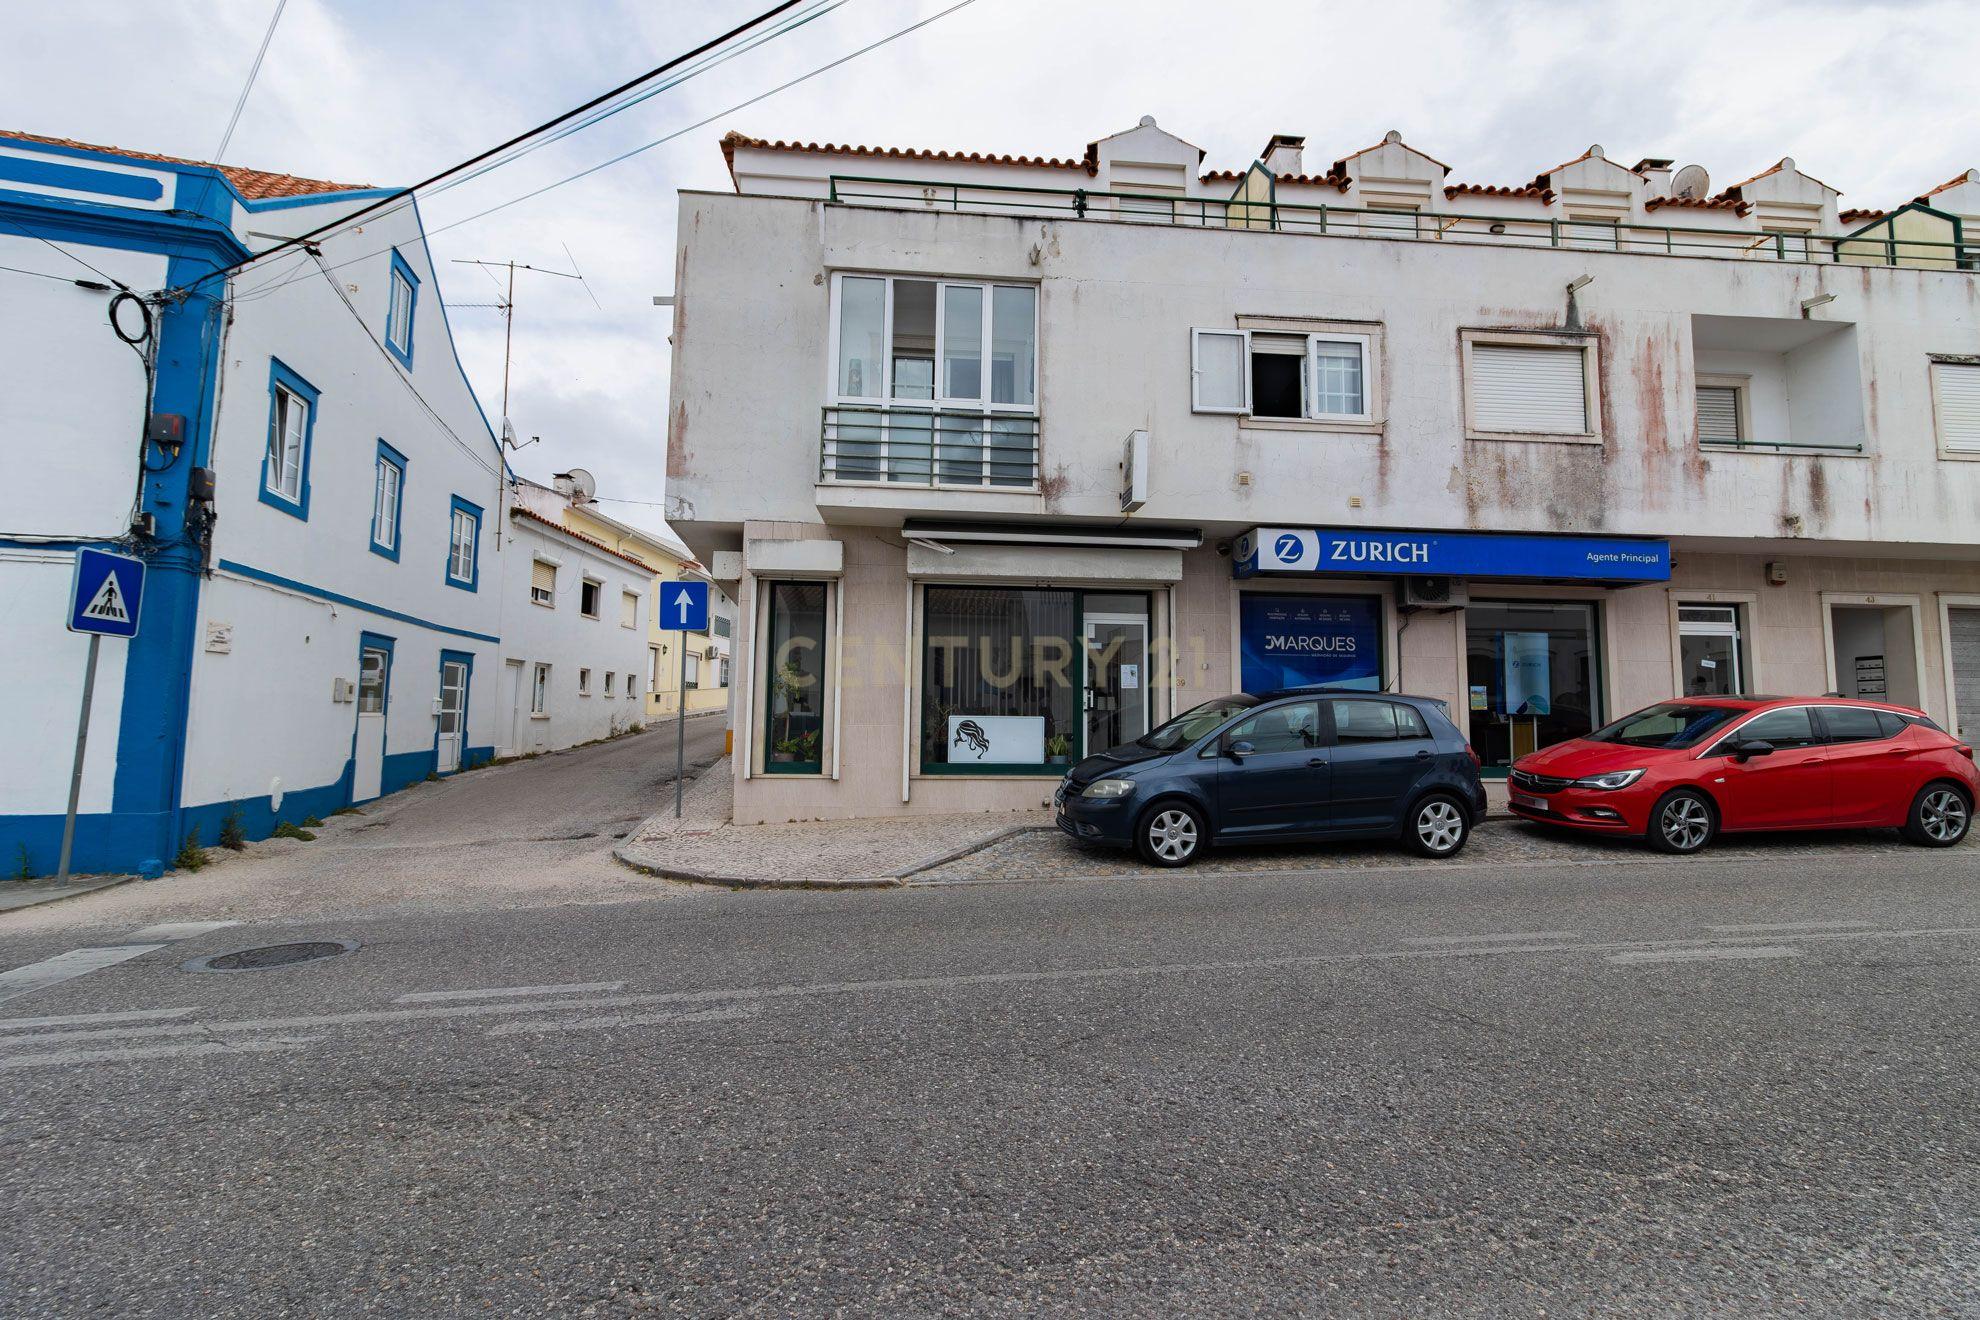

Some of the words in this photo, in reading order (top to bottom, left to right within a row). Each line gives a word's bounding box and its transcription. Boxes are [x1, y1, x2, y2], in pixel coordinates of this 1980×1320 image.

[1331, 540, 1429, 562] ZURICH
[1586, 552, 1619, 563] Agente
[1621, 553, 1659, 564] Principal
[1265, 635, 1356, 651] JMARQUES
[1176, 678, 1186, 687] 39
